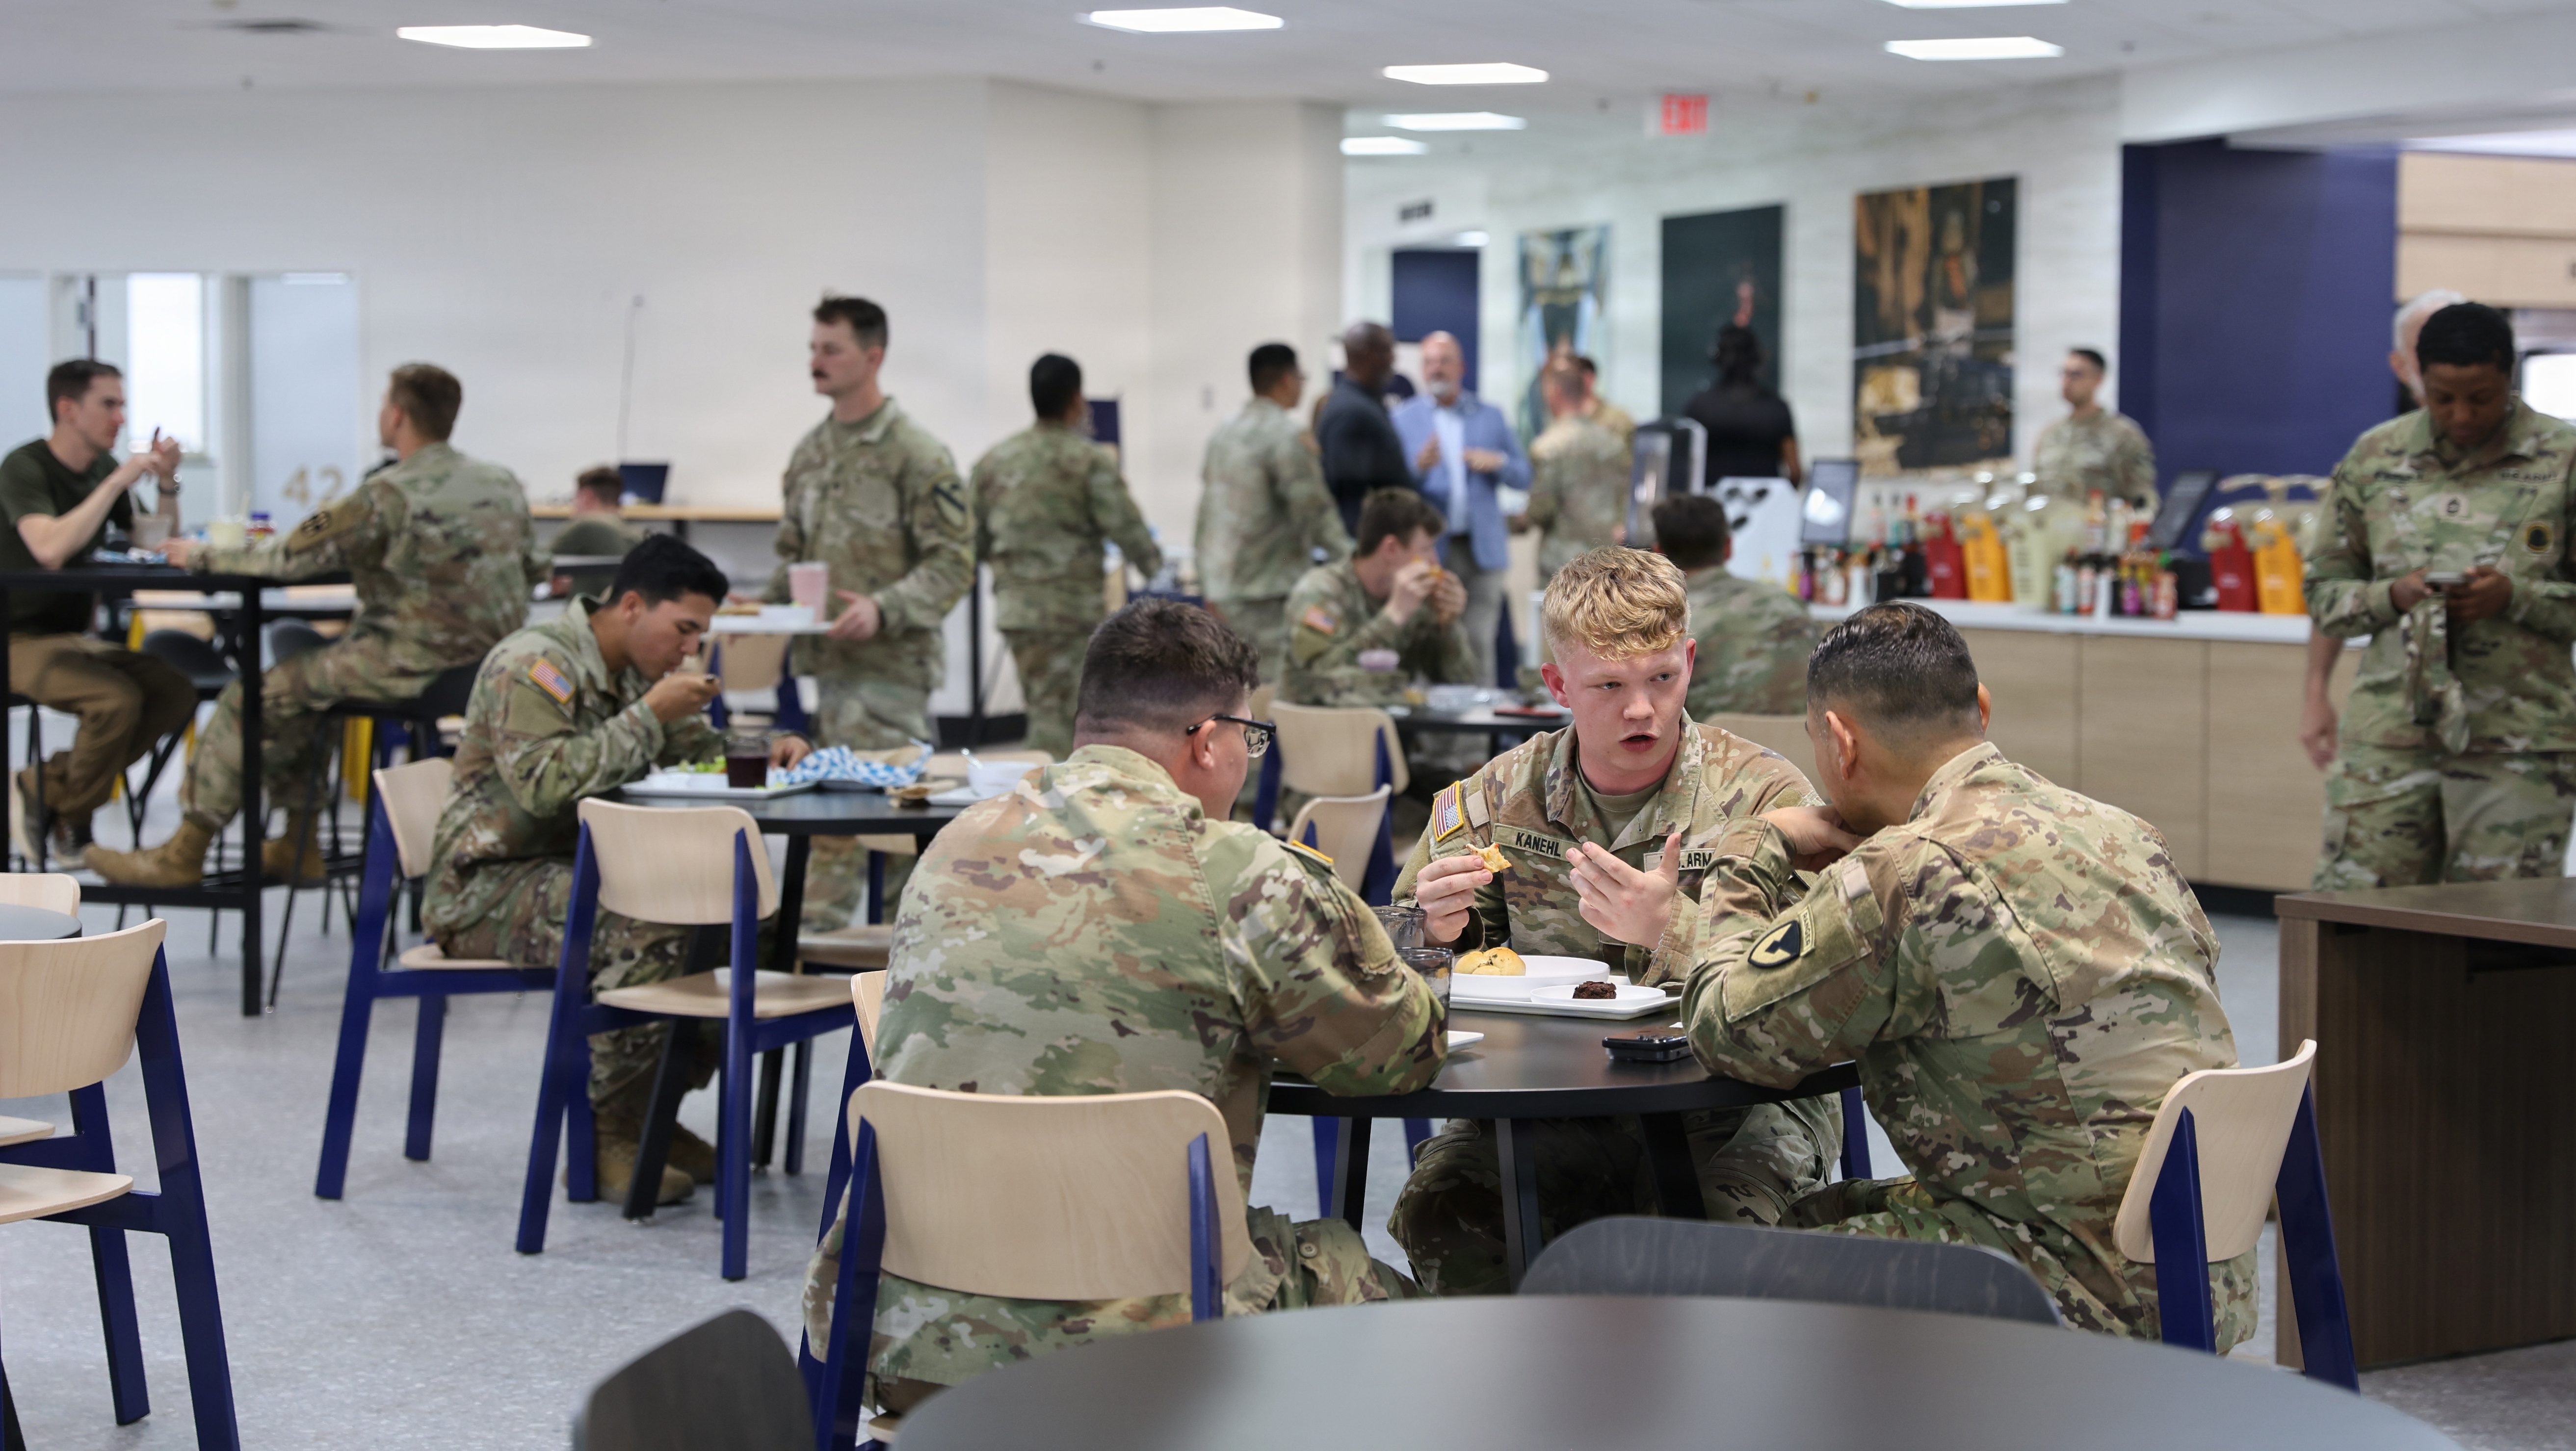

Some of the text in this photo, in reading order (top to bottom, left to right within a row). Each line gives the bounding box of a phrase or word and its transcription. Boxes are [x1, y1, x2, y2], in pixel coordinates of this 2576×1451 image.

[1661, 94, 1708, 133] EXIT
[1515, 832, 1561, 857] KANEHL
[1687, 853, 1713, 867] ARM
[1803, 913, 1811, 946] RANGER
